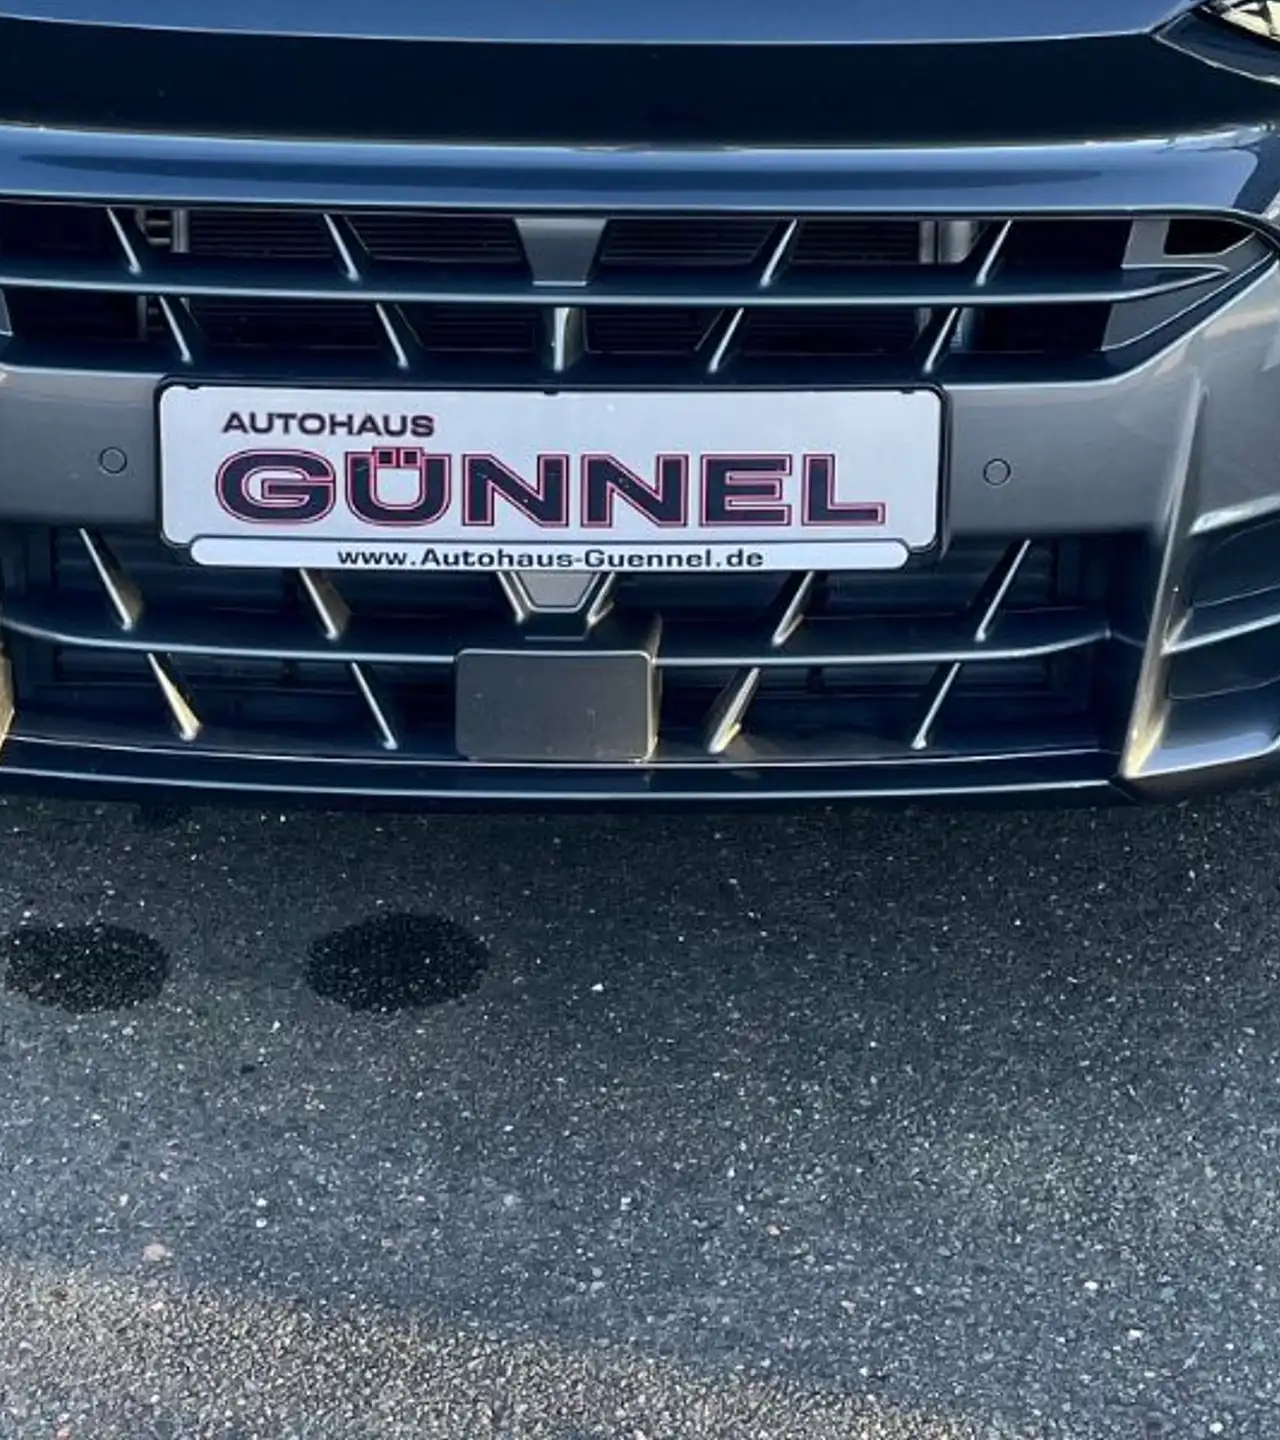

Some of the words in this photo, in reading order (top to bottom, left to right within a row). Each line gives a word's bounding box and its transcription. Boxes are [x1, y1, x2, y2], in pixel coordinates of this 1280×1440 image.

[221, 411, 435, 437] AUTOHAUS
[215, 446, 886, 527] GÜNNEL
[337, 547, 765, 569] www.Autohaus-Guennel.de
